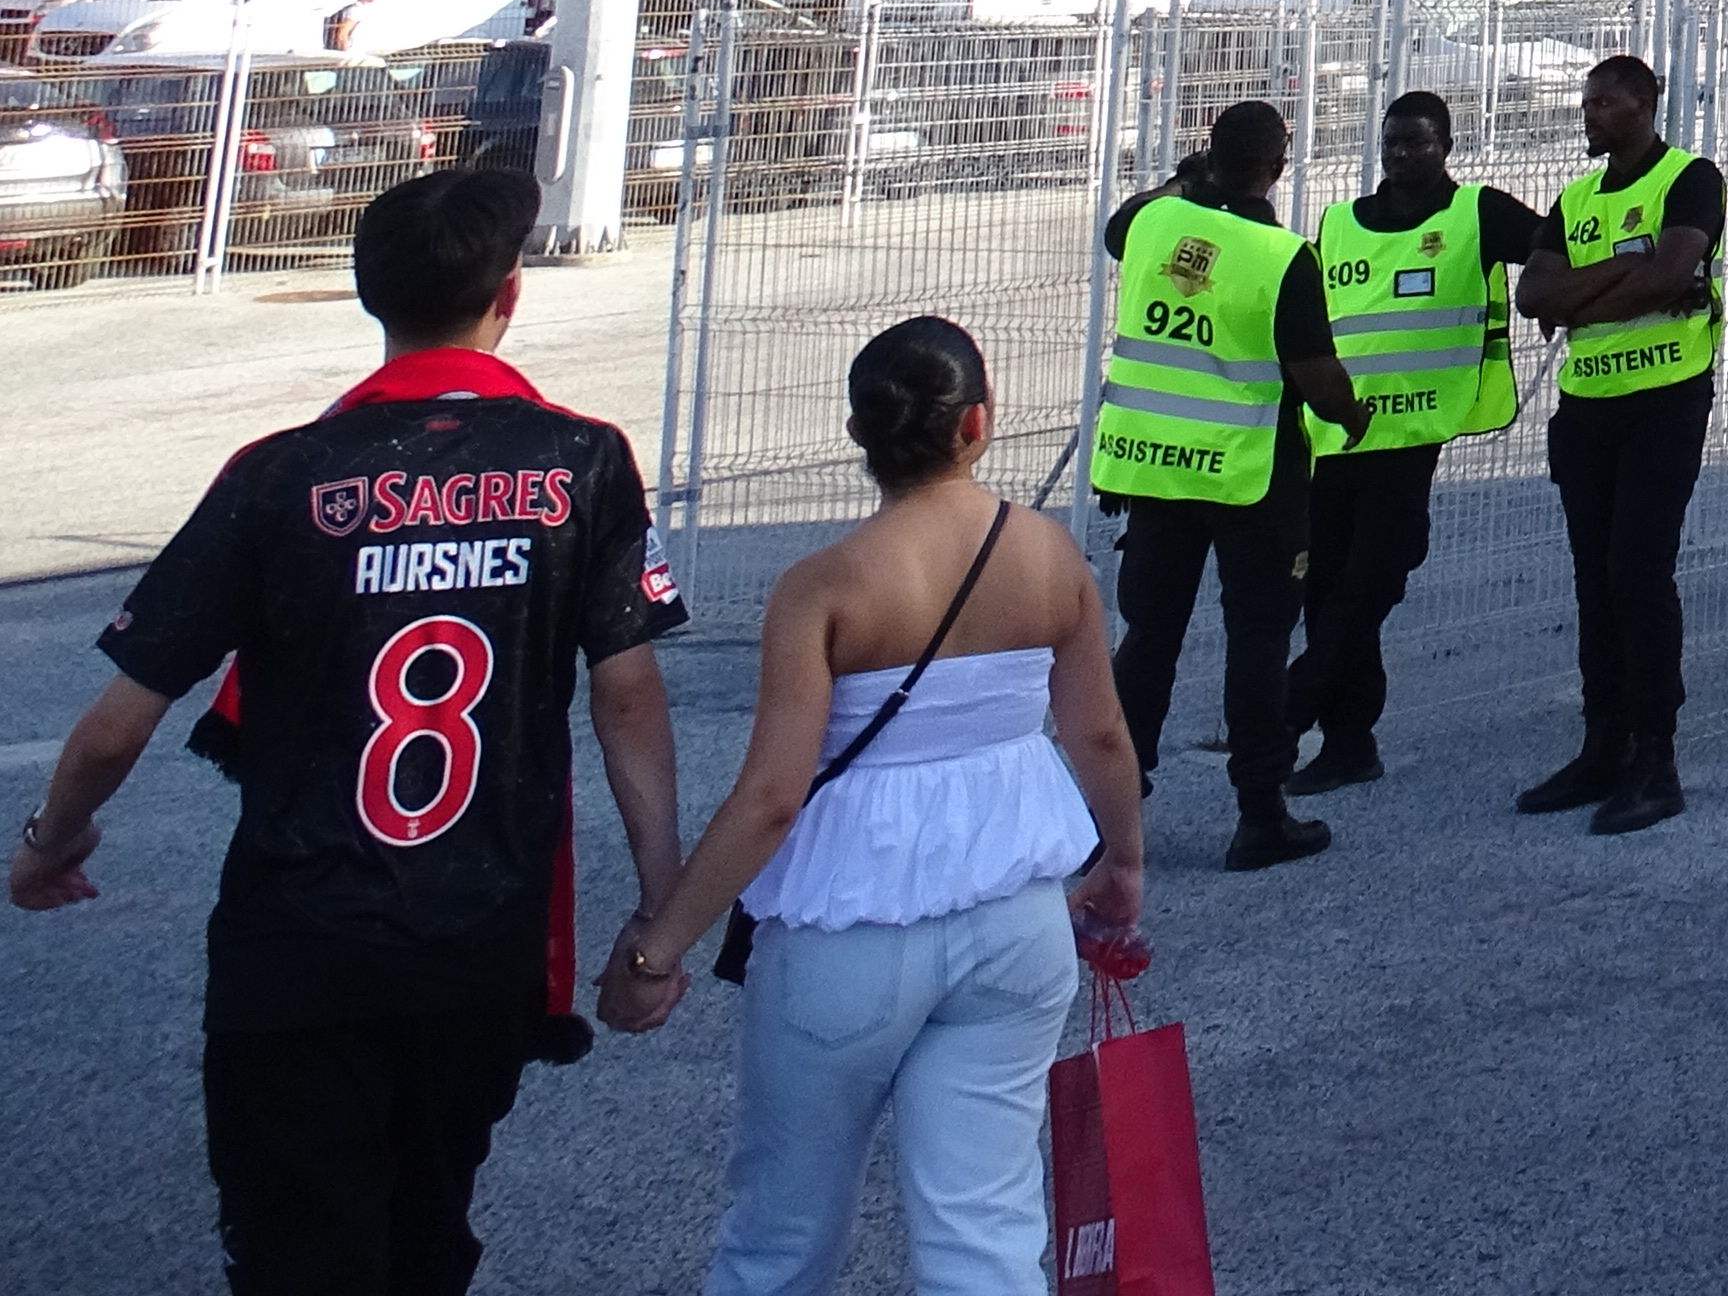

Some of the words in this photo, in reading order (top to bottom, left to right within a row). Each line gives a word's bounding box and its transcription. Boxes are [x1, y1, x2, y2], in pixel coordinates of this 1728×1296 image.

[1143, 300, 1214, 347] 920
[369, 468, 574, 532] SAGRES
[355, 538, 532, 594] AURSNES
[356, 615, 494, 846] 8
